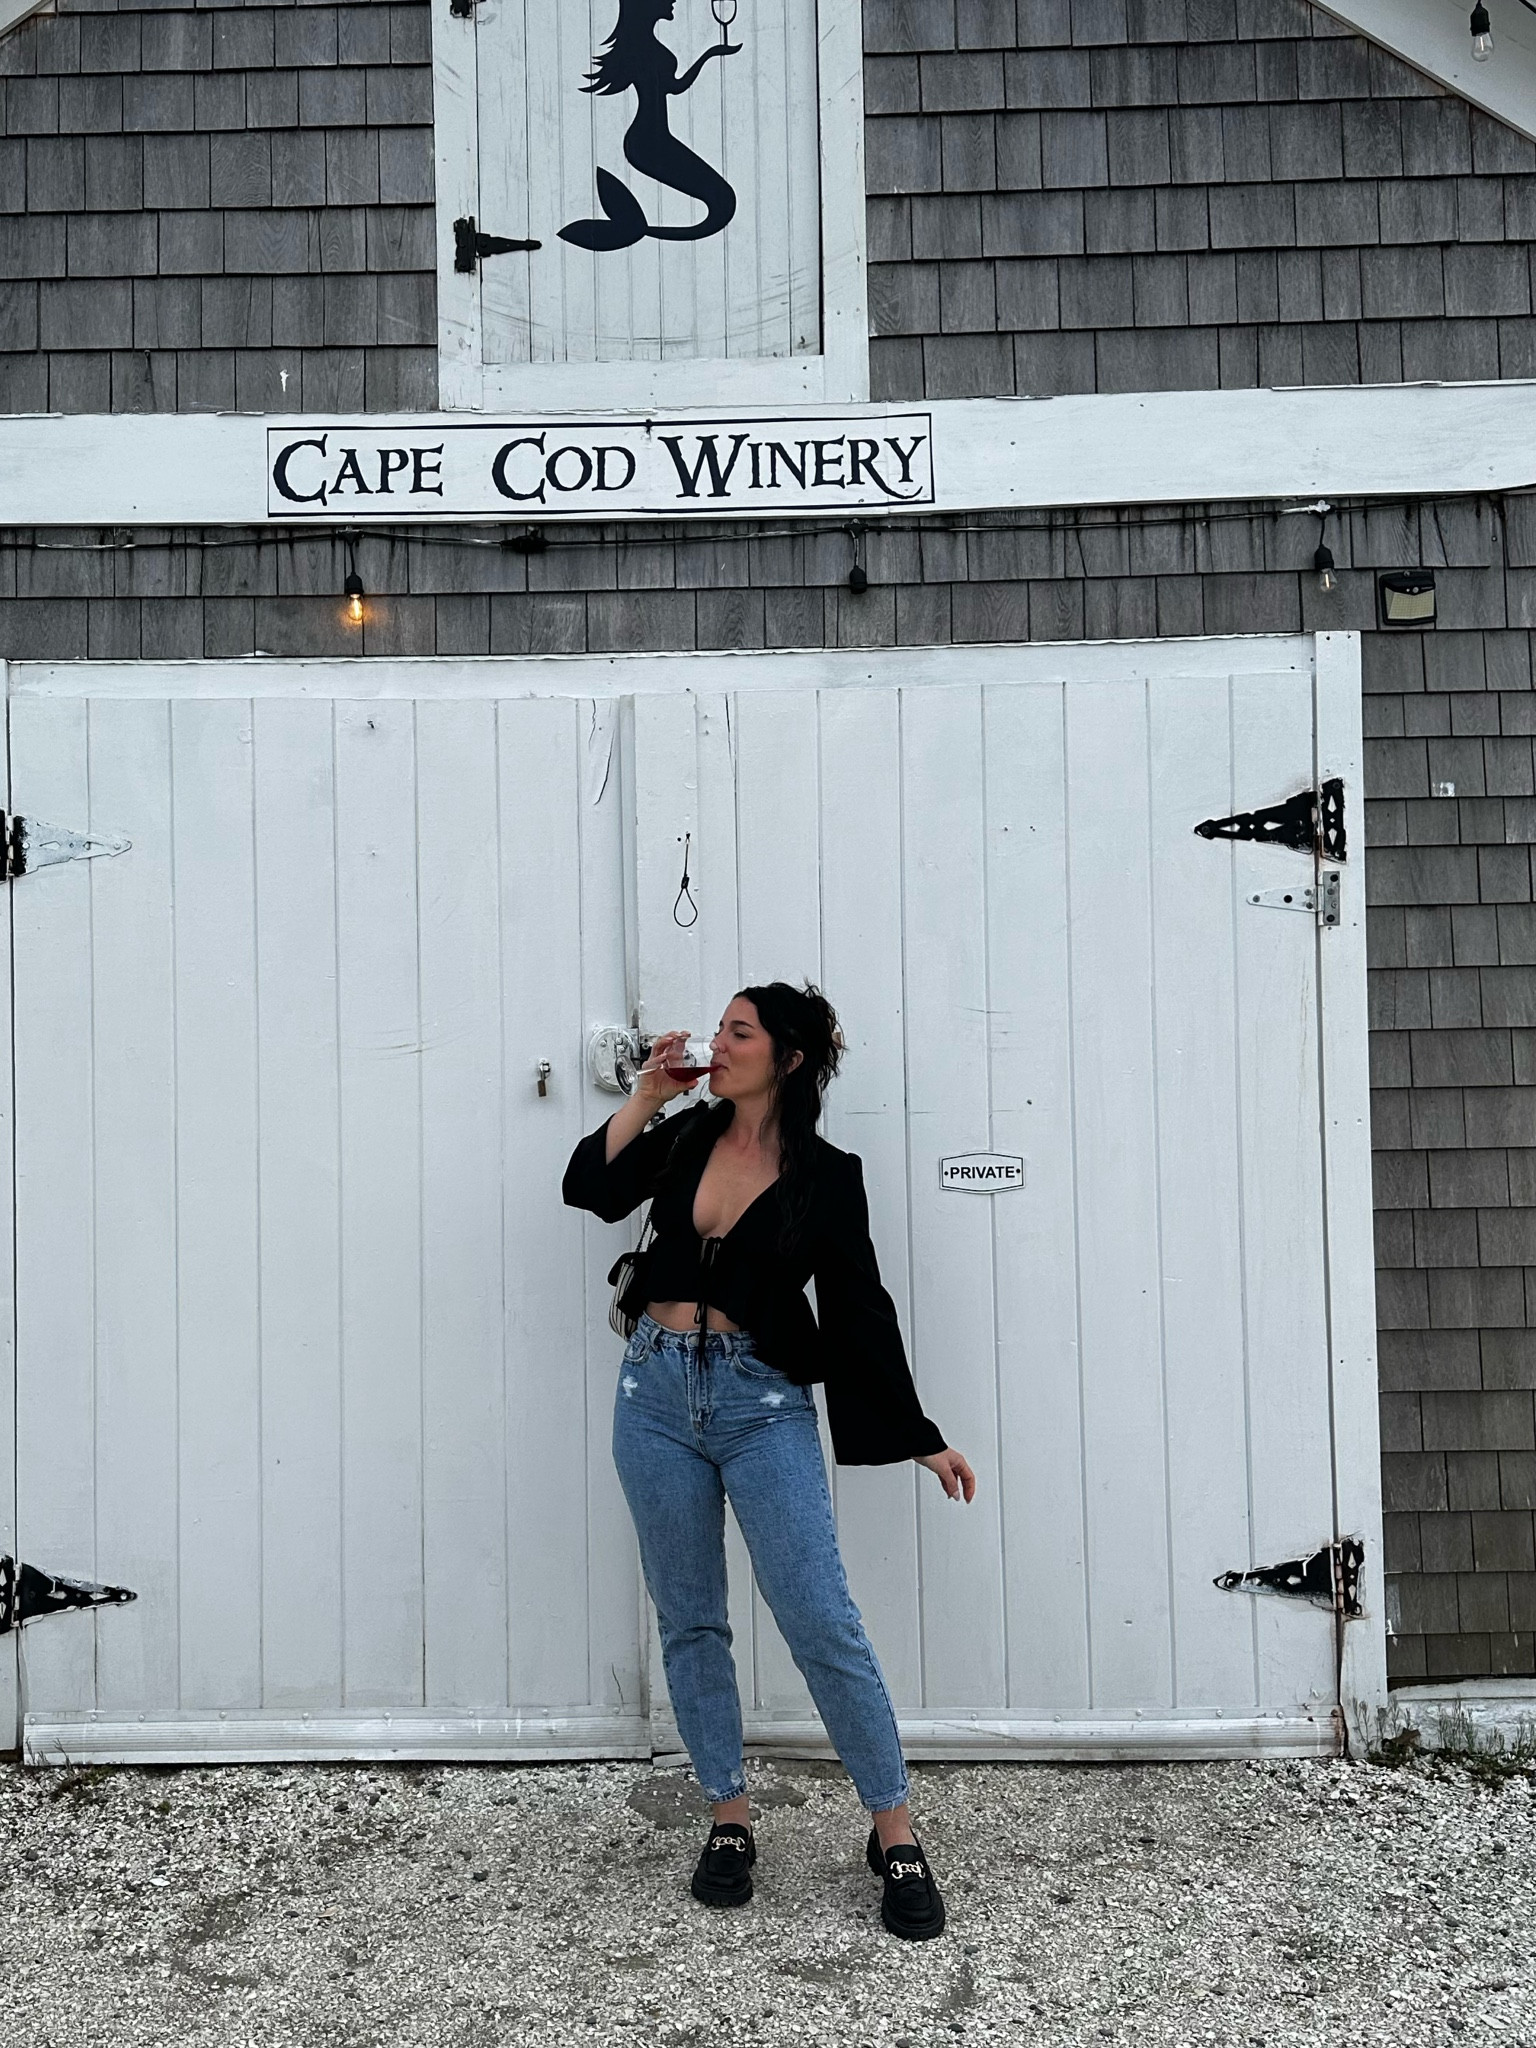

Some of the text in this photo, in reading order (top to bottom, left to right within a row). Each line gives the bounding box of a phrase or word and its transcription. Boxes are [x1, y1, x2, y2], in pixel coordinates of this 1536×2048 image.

[272, 431, 927, 507] CAPE COD WINERY
[950, 1166, 1016, 1180] PRIVATE
